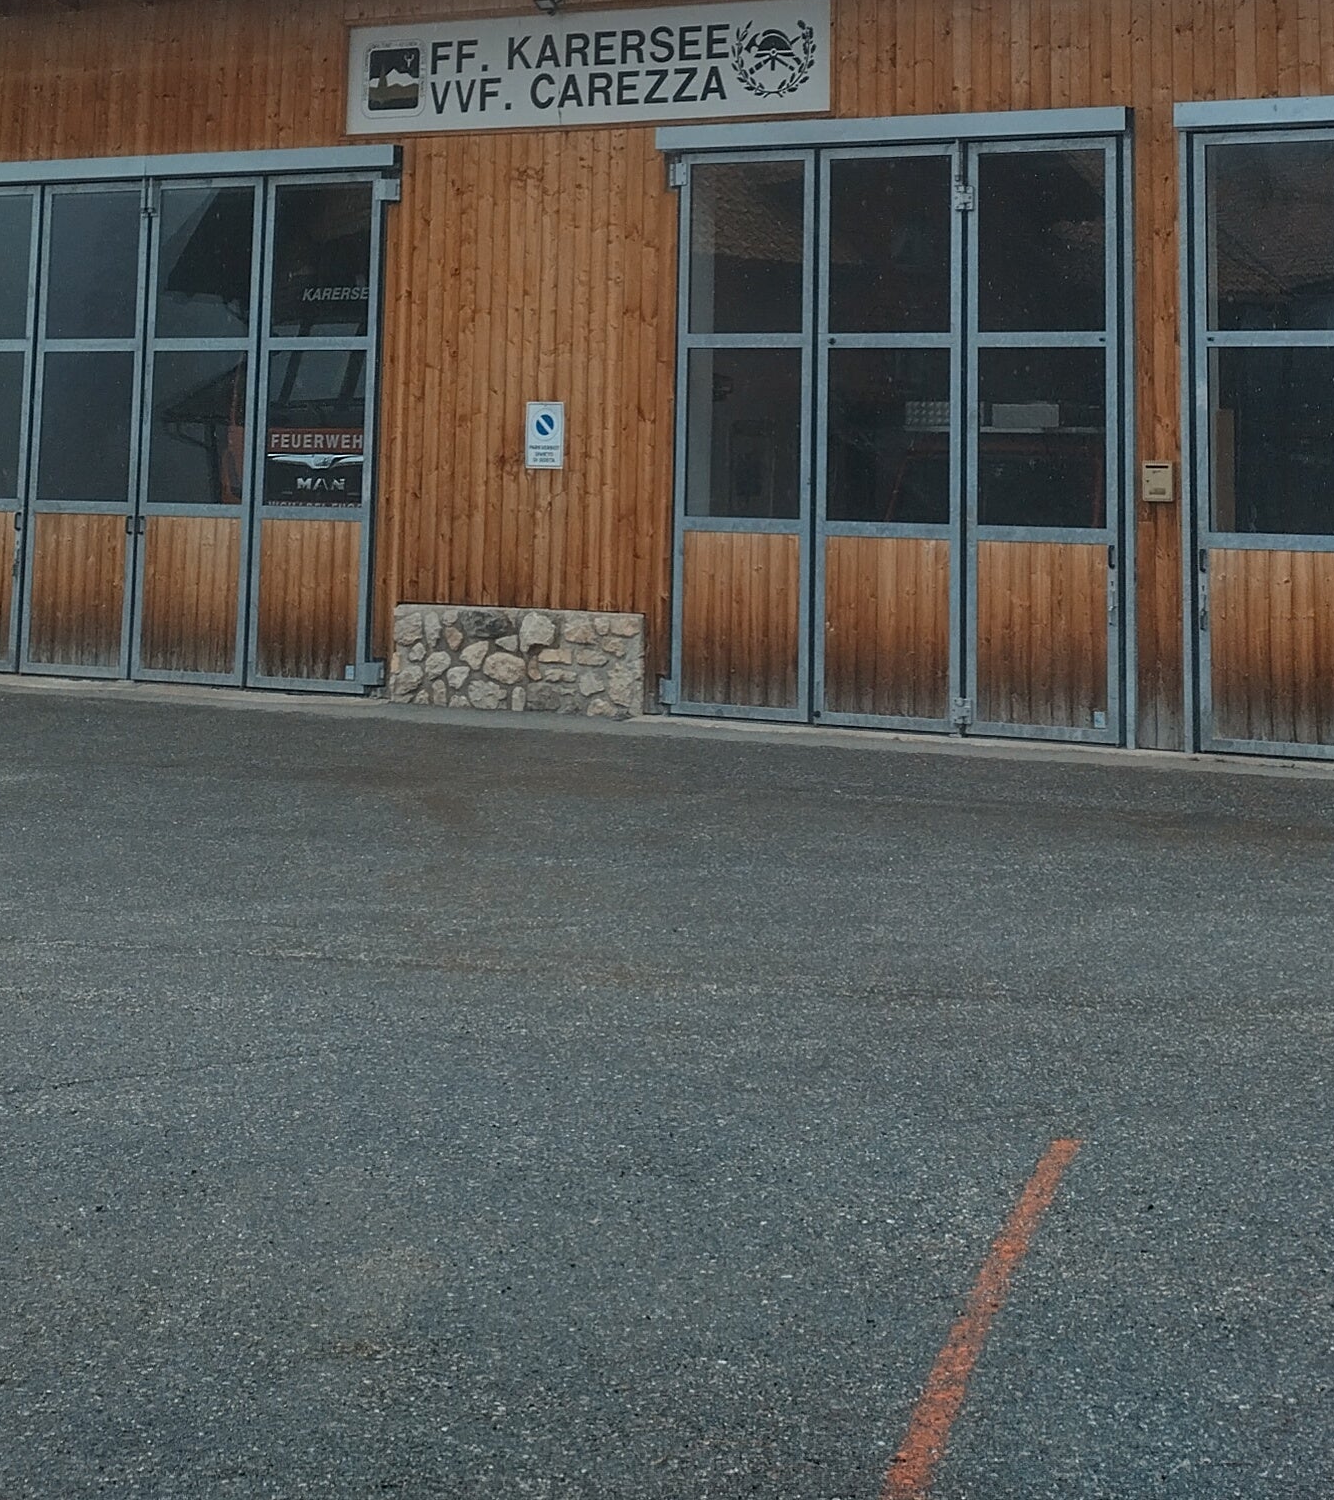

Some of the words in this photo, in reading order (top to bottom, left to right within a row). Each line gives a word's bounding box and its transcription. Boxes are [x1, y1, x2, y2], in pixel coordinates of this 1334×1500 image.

[430, 40, 488, 75] FF.
[507, 24, 730, 70] KARERSEE
[430, 77, 511, 114] VVF.
[530, 66, 727, 109] CAREZZA
[297, 478, 345, 490] MAN
